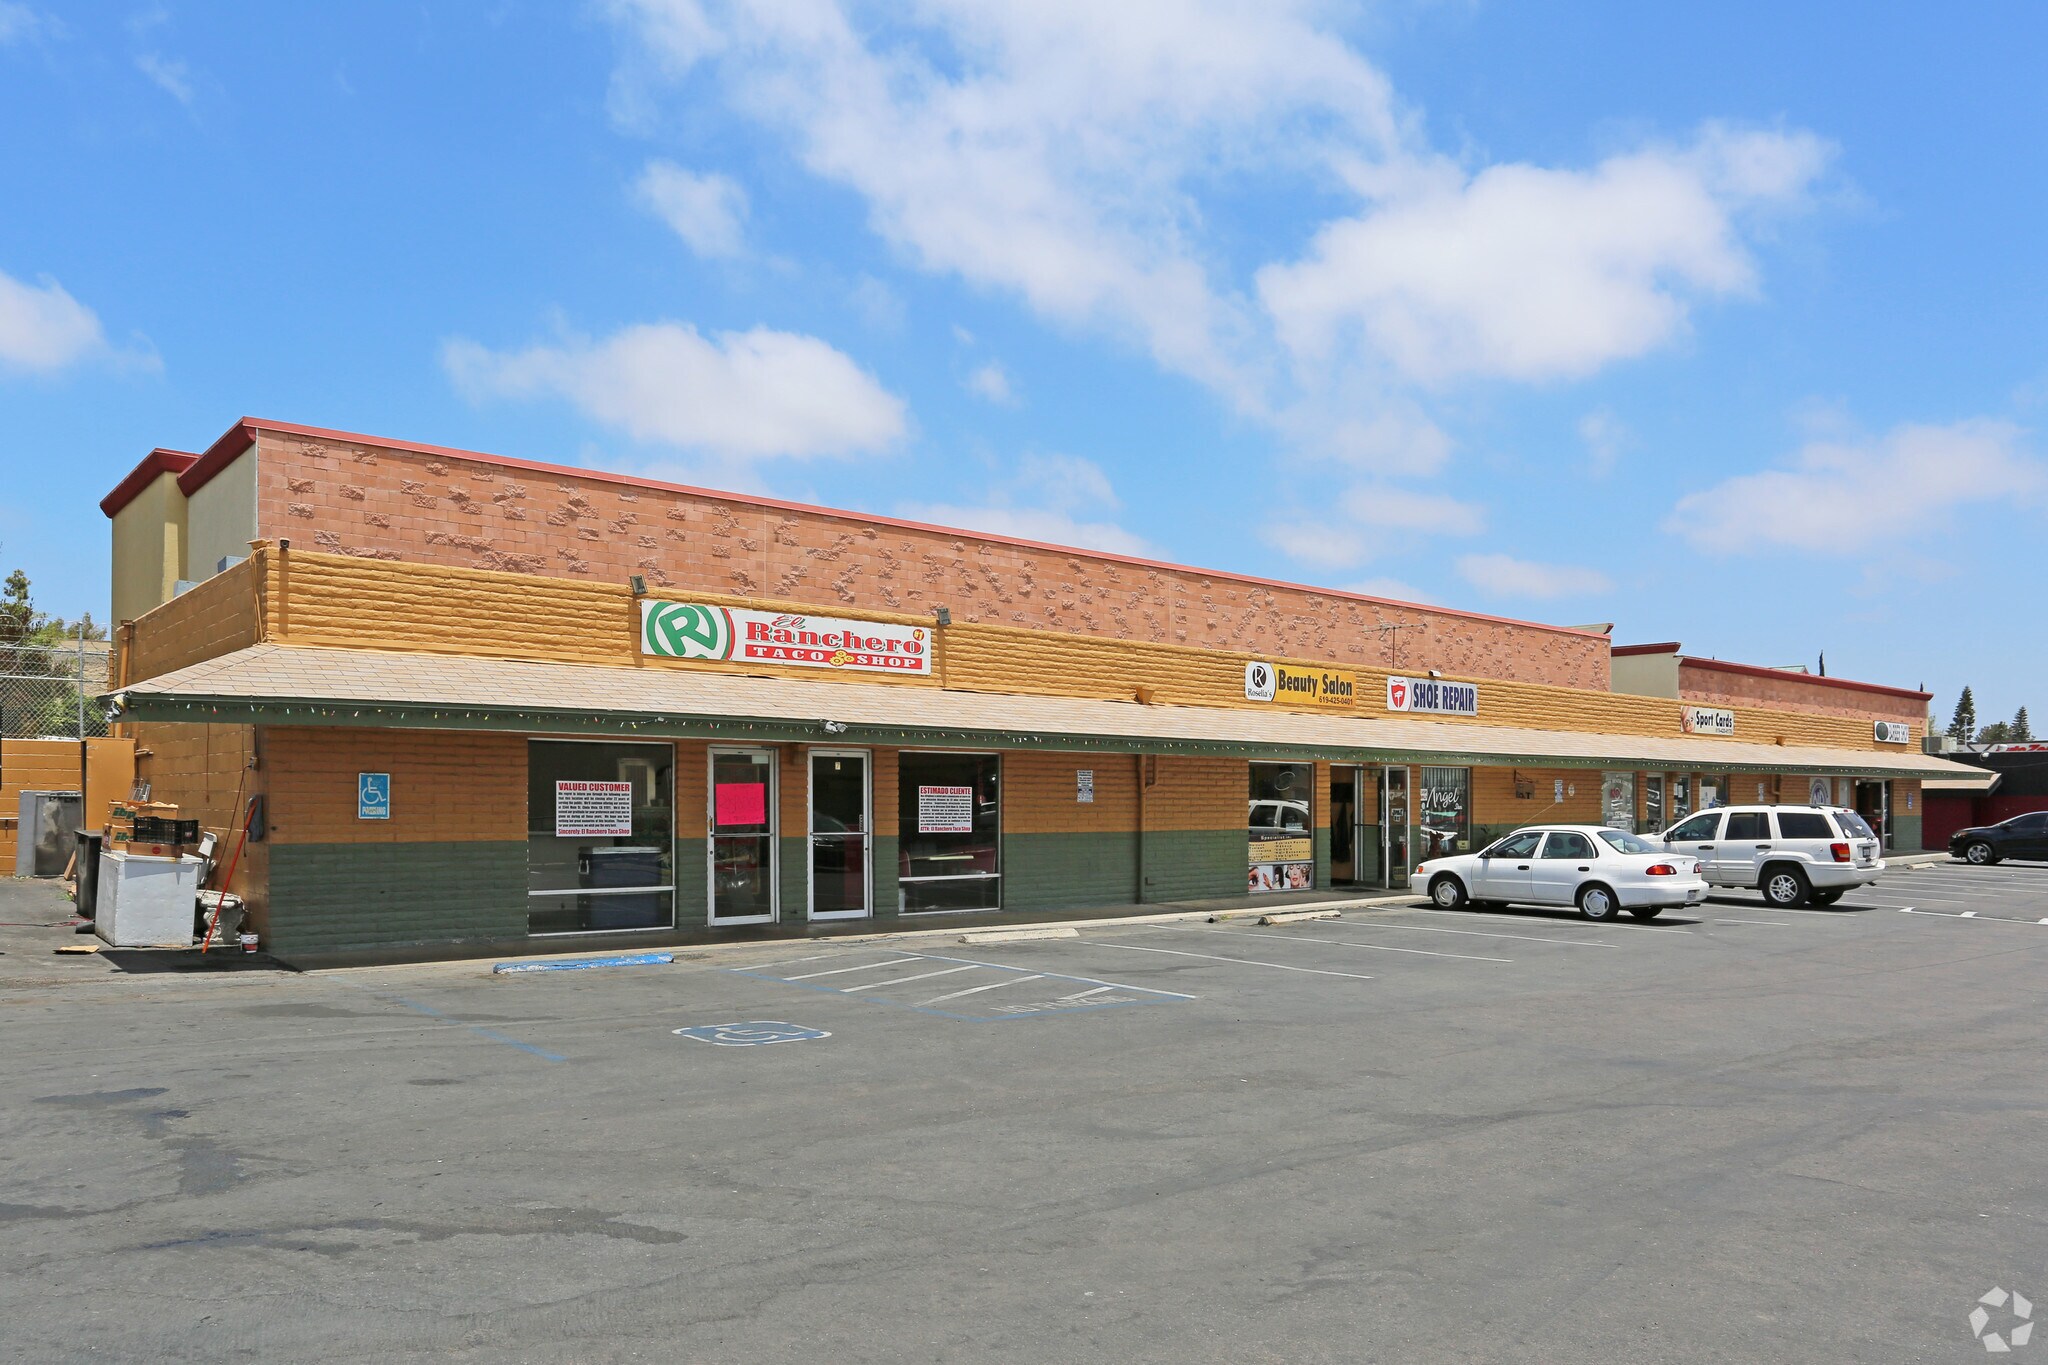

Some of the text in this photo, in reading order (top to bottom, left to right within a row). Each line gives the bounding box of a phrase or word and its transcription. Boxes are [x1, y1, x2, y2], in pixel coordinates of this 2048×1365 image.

[771, 615, 806, 630] El
[745, 621, 924, 655] Ranchero
[753, 647, 916, 667] TACO SHOP
[1278, 669, 1353, 698] Beauty Salon
[1413, 682, 1475, 712] SHOE REPAIR
[1696, 710, 1732, 728] Sport Cards
[559, 783, 630, 792] VALUED CUSTOMER
[950, 787, 971, 795] CLIENTE
[1426, 786, 1460, 808] Angel
[362, 806, 386, 815] PARKING
